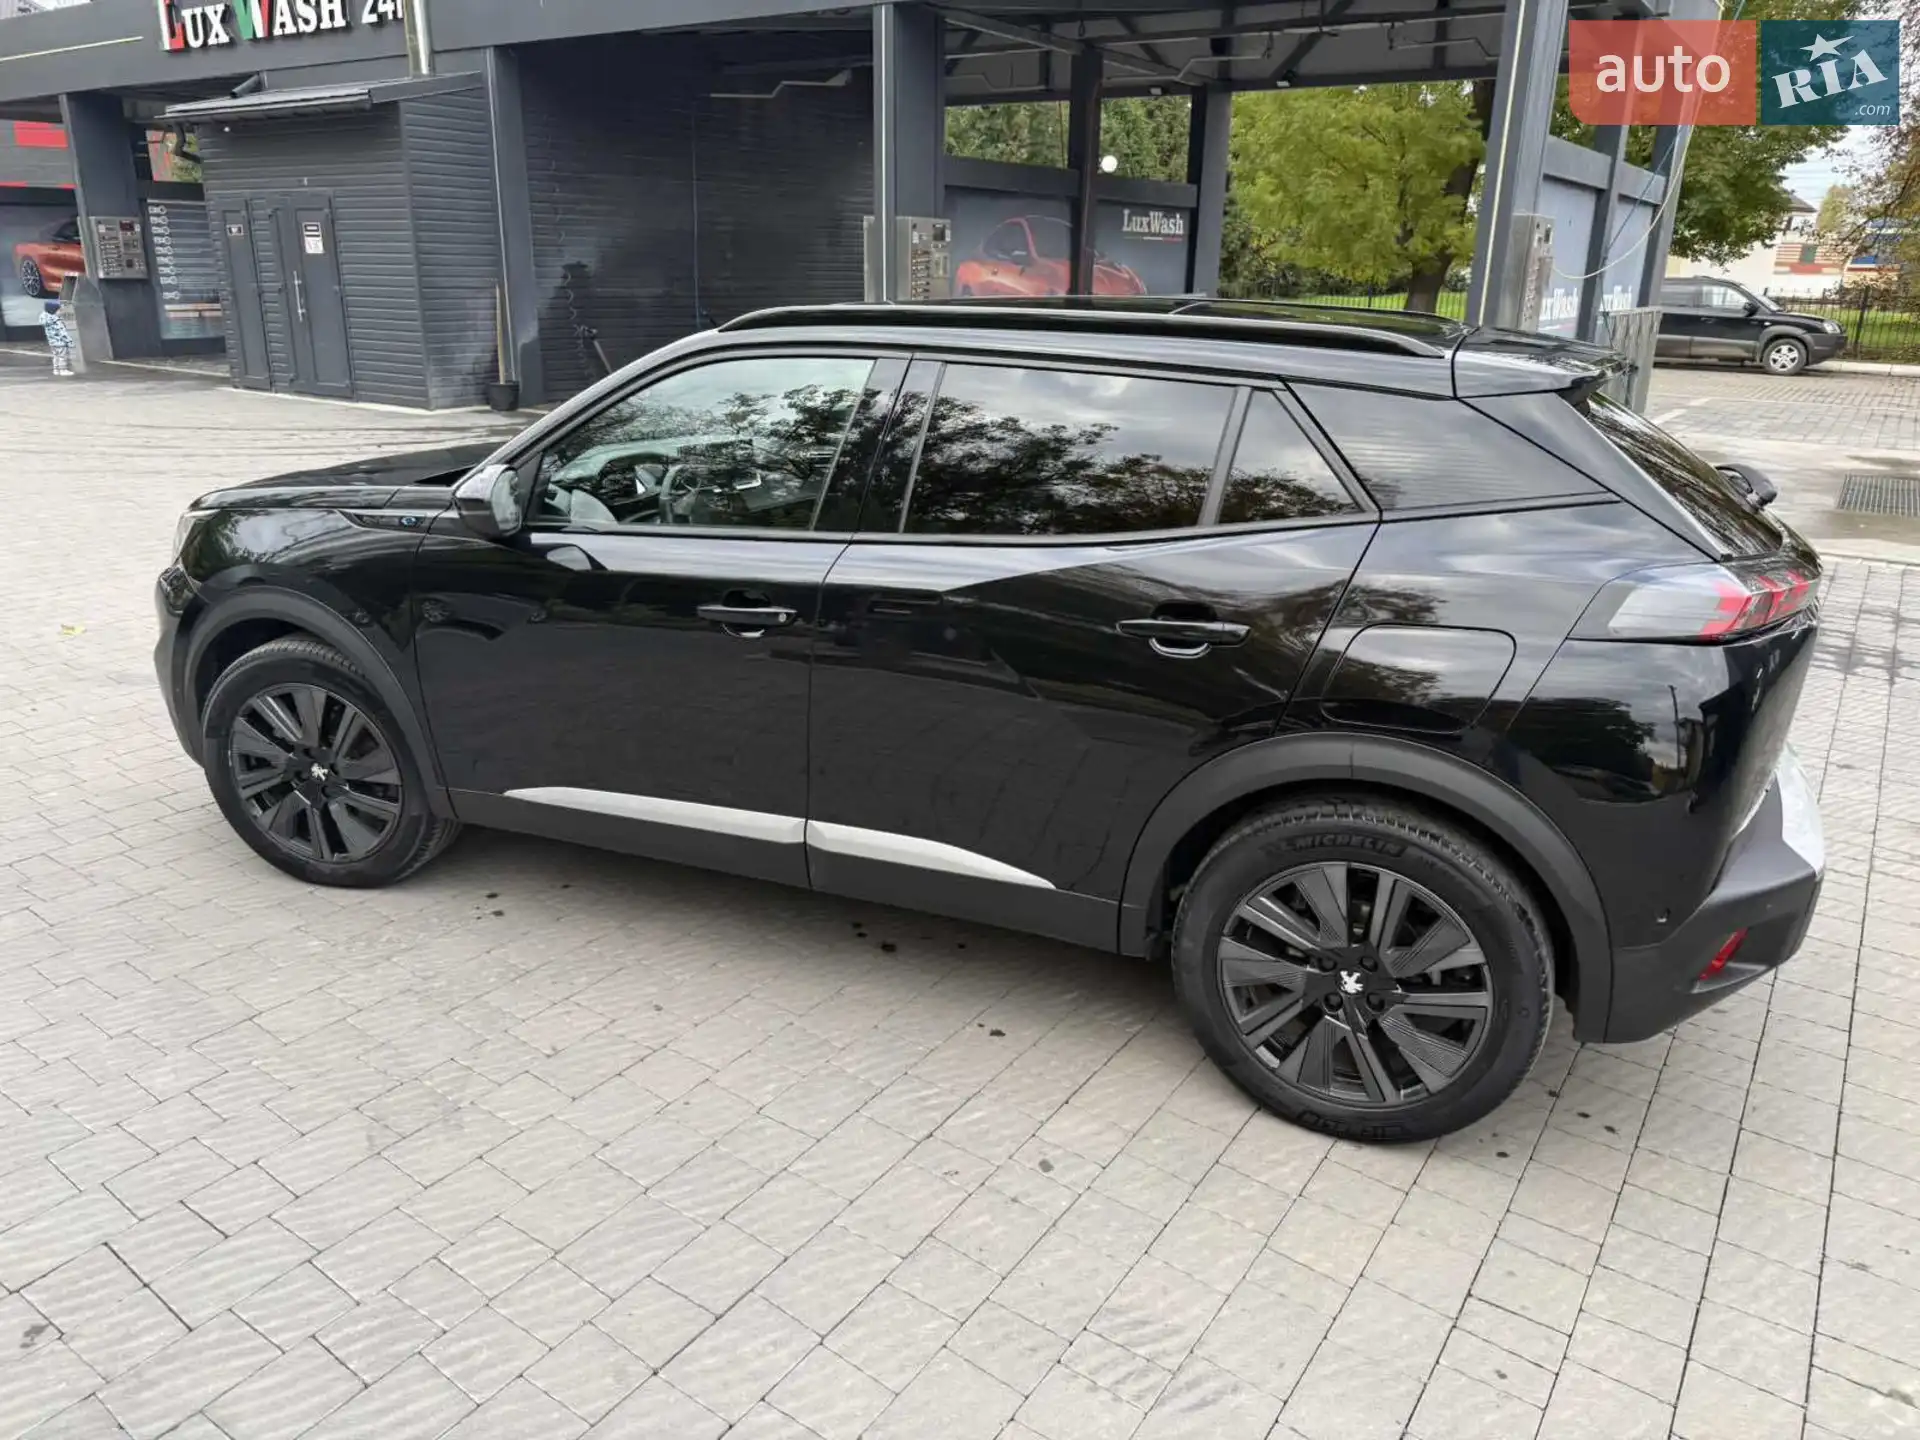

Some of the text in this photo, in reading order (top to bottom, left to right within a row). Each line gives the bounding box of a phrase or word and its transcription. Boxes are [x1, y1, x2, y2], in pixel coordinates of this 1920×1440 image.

[361, 0, 404, 24] 24
[1122, 209, 1184, 234] LuxWash
[1294, 833, 1406, 857] MICHELIN
